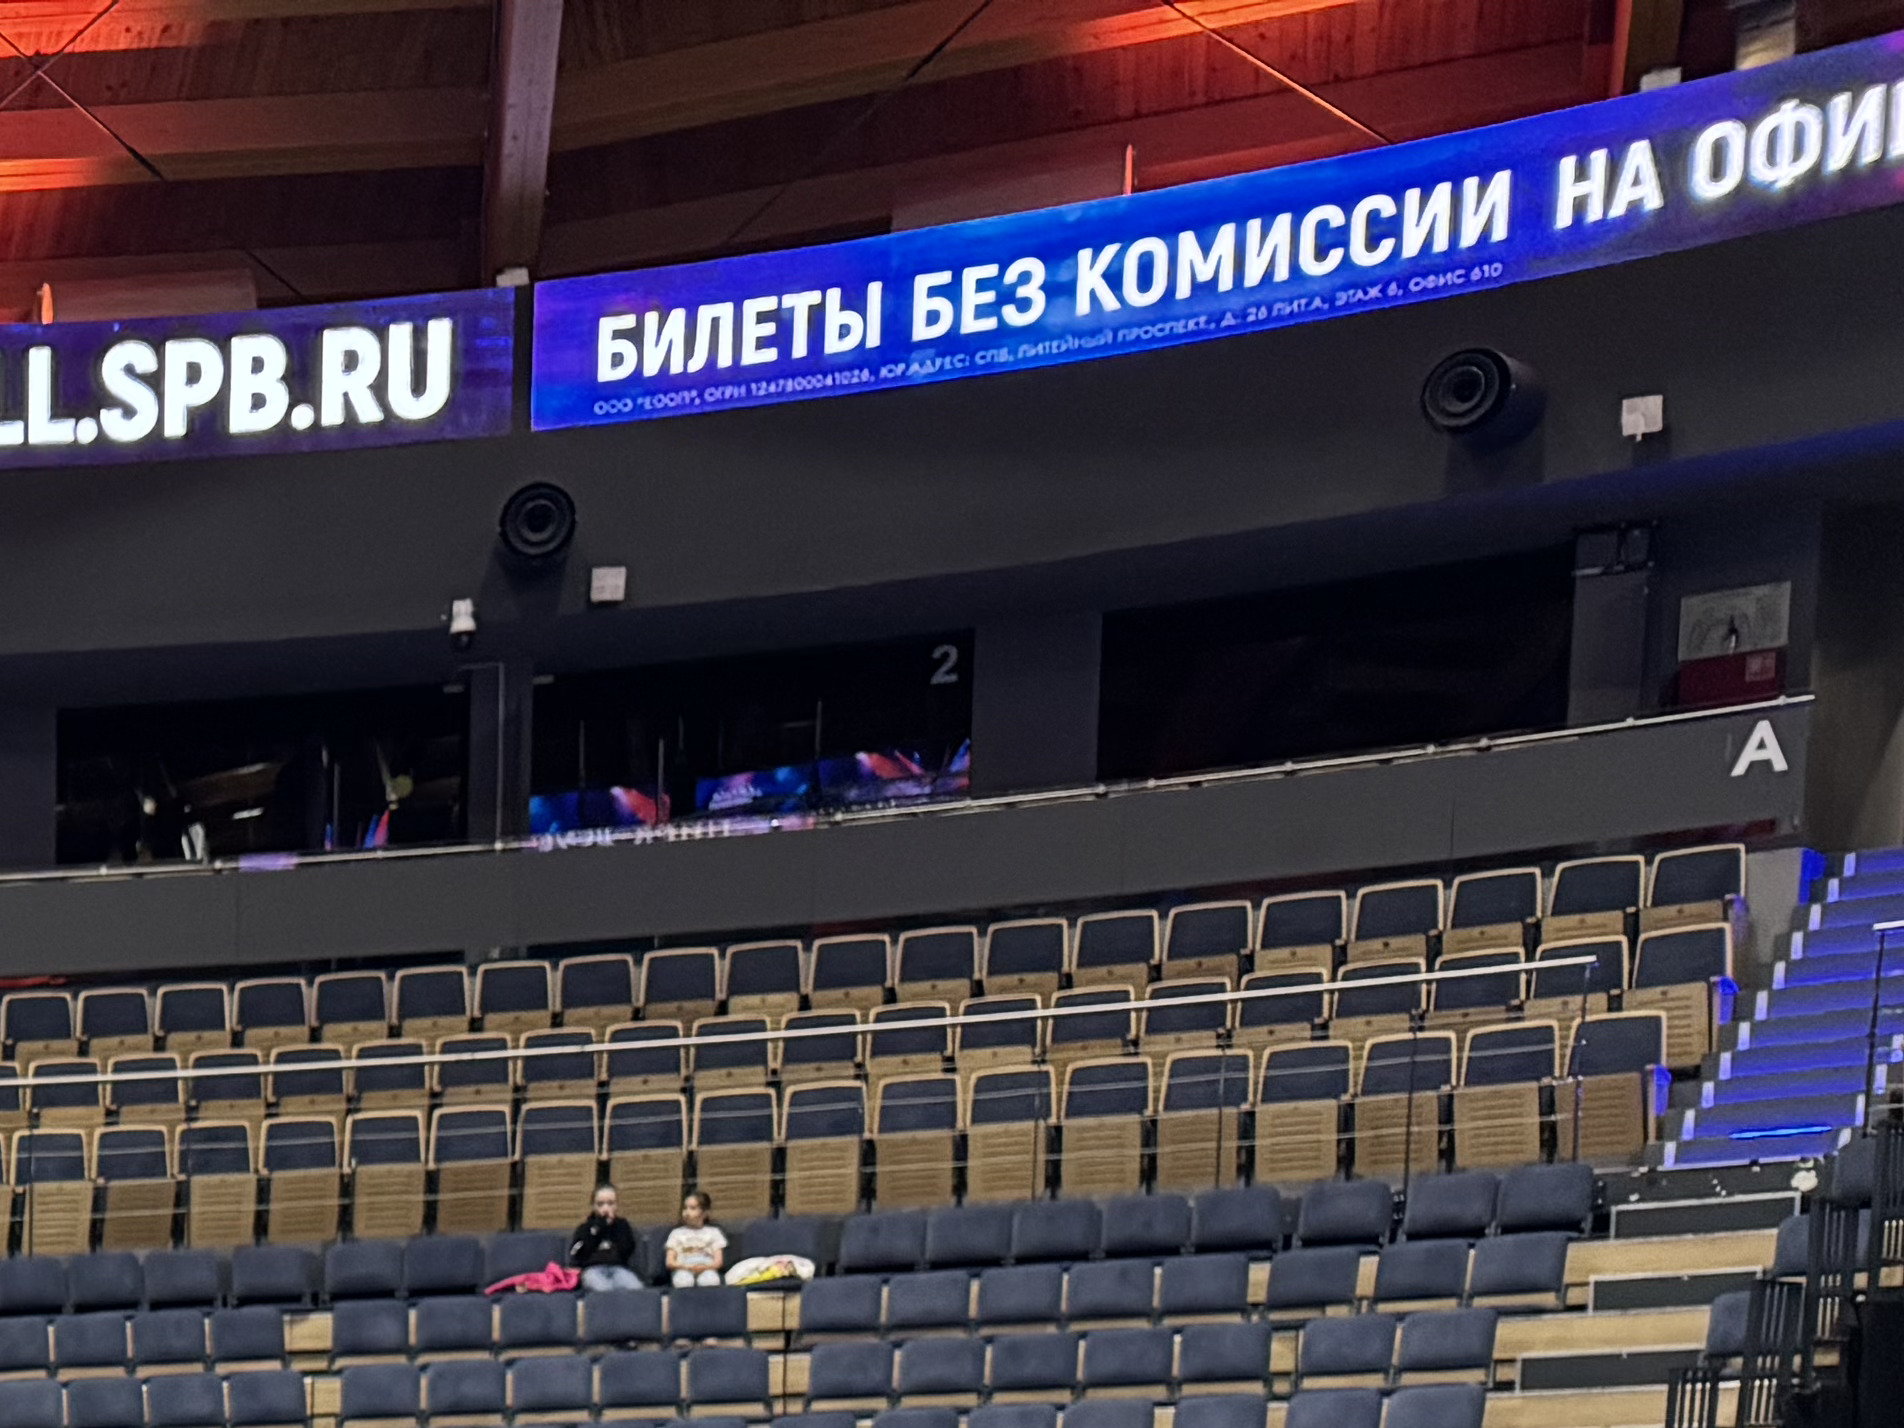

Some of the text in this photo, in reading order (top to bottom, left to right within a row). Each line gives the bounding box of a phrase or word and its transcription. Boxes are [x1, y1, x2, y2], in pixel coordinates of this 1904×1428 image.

[596, 281, 883, 383] БИЛЕТЫ
[911, 257, 1047, 342] БЕЗ
[1075, 169, 1512, 318] КОМИССИИ
[1554, 139, 1663, 230] НА
[930, 644, 959, 685] 2
[1730, 719, 1789, 777] A
